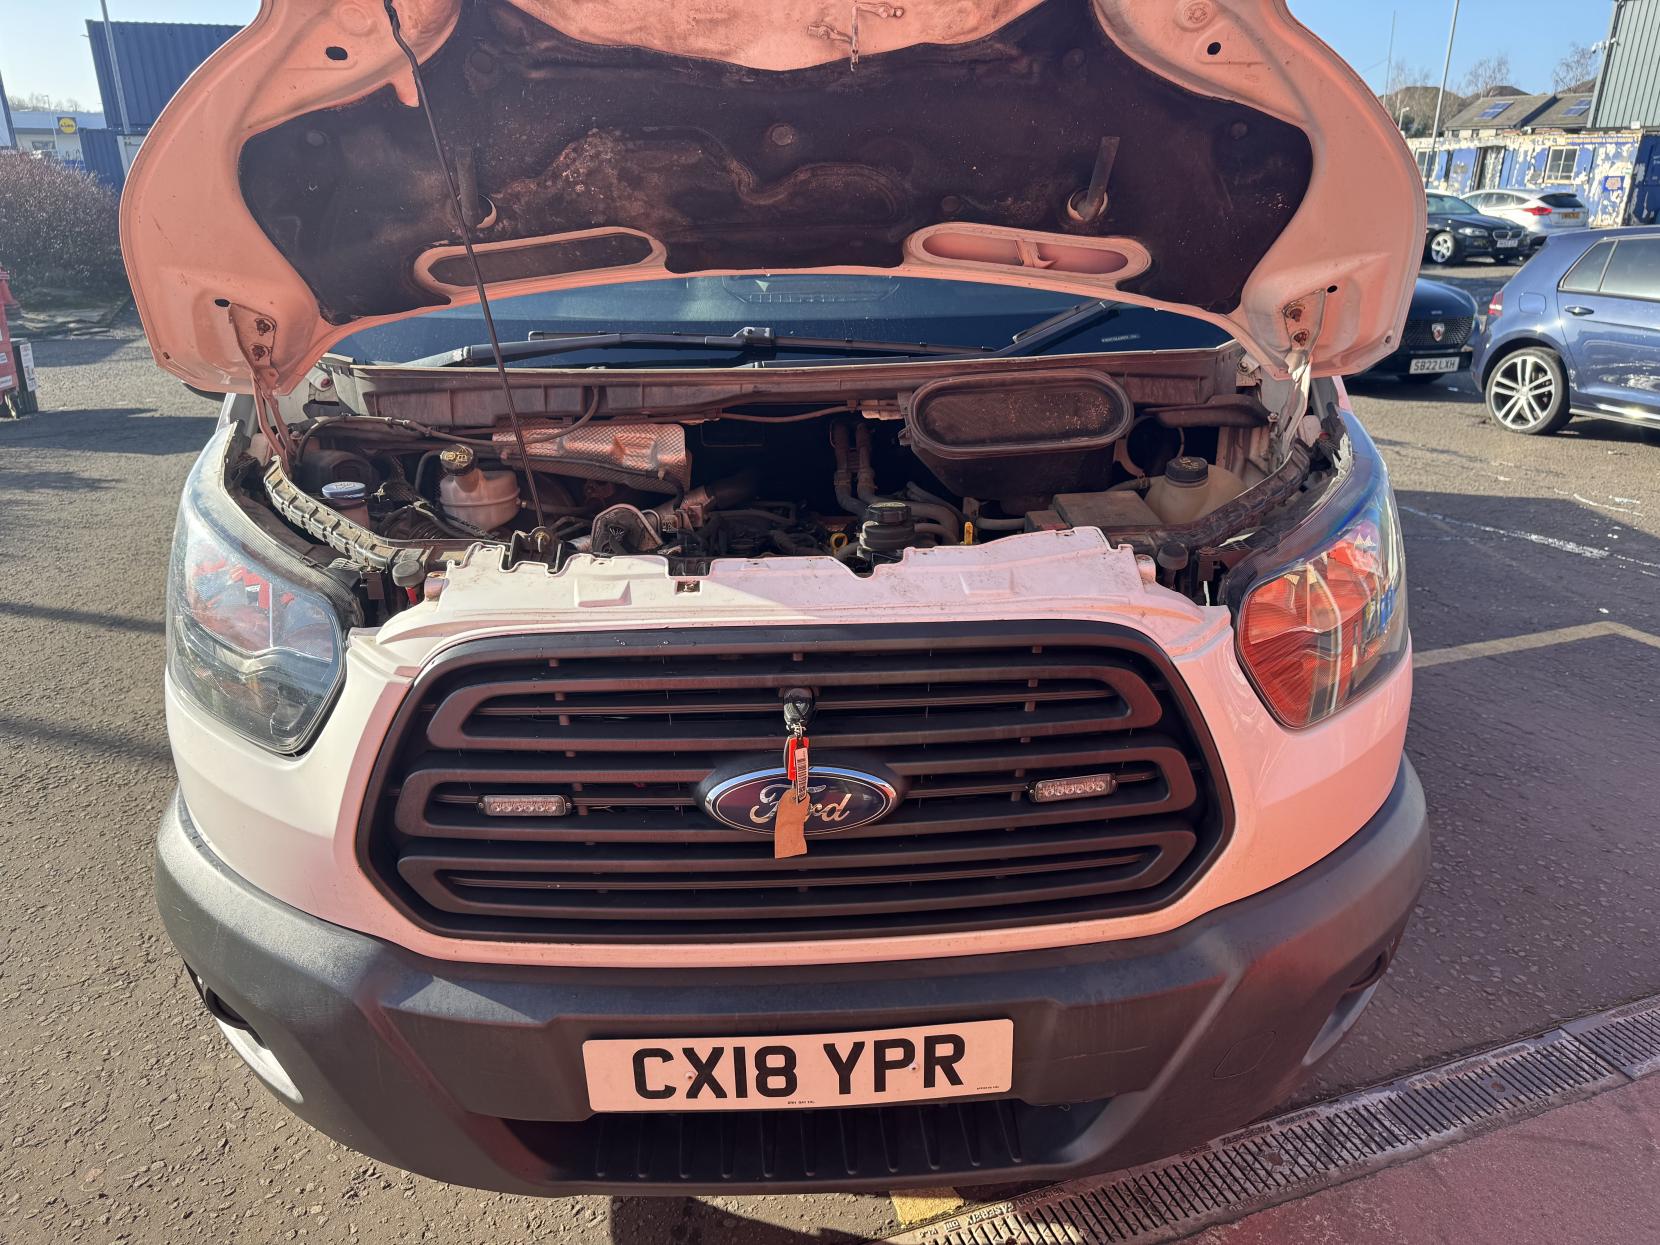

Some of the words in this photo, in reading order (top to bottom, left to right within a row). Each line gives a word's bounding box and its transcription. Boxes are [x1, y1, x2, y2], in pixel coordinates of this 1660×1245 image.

[1413, 360, 1438, 371] SB22
[1439, 359, 1456, 370] LXH
[632, 1045, 798, 1100] CX18
[823, 1033, 966, 1095] YPR
